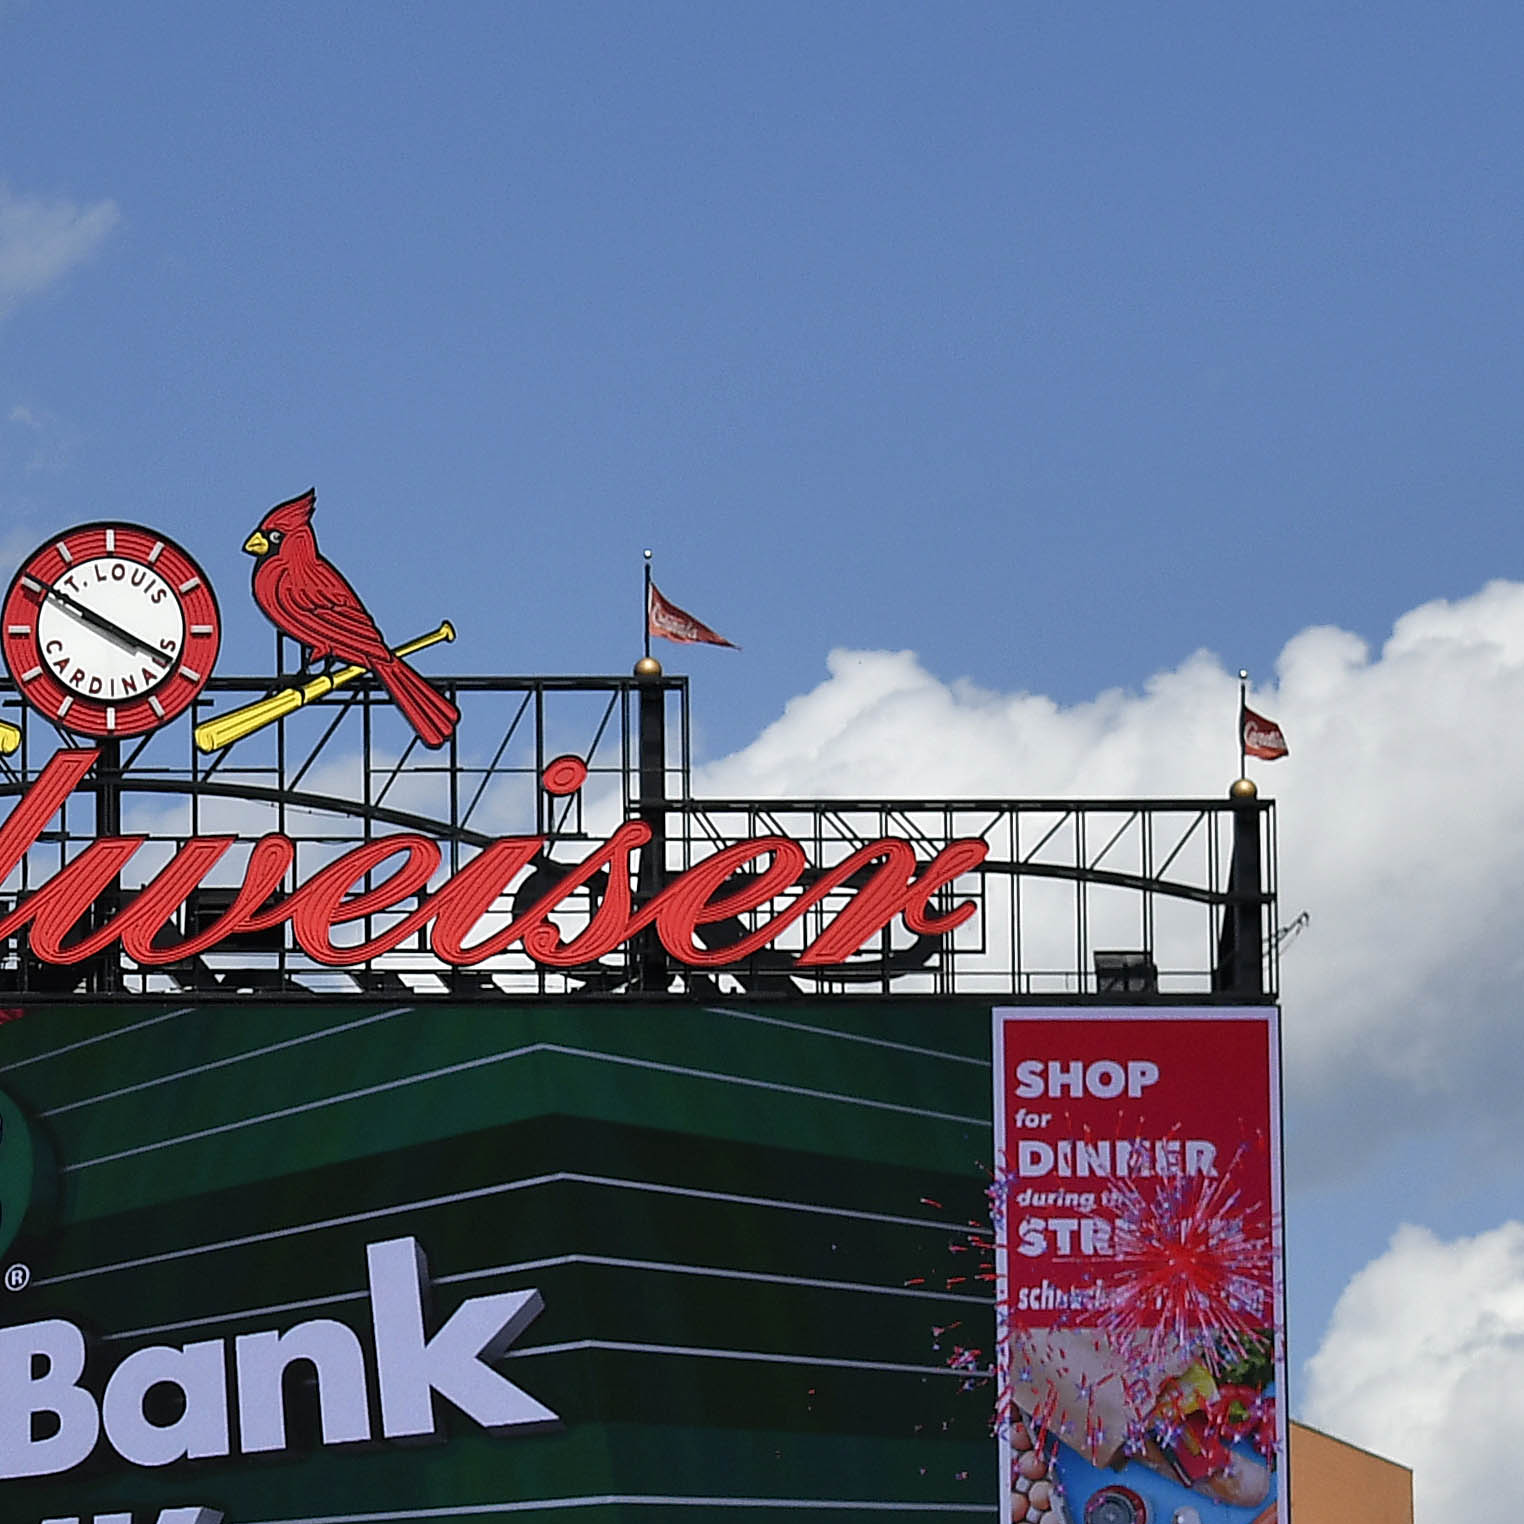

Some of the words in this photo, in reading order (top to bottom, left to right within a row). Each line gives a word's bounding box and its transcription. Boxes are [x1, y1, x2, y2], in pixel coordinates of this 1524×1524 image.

[94, 563, 167, 604] LOUIS
[1015, 1059, 1160, 1099] SHOP
[1014, 1107, 1052, 1128] for
[1018, 1139, 1218, 1178] DINNER
[1015, 1189, 1096, 1211] during
